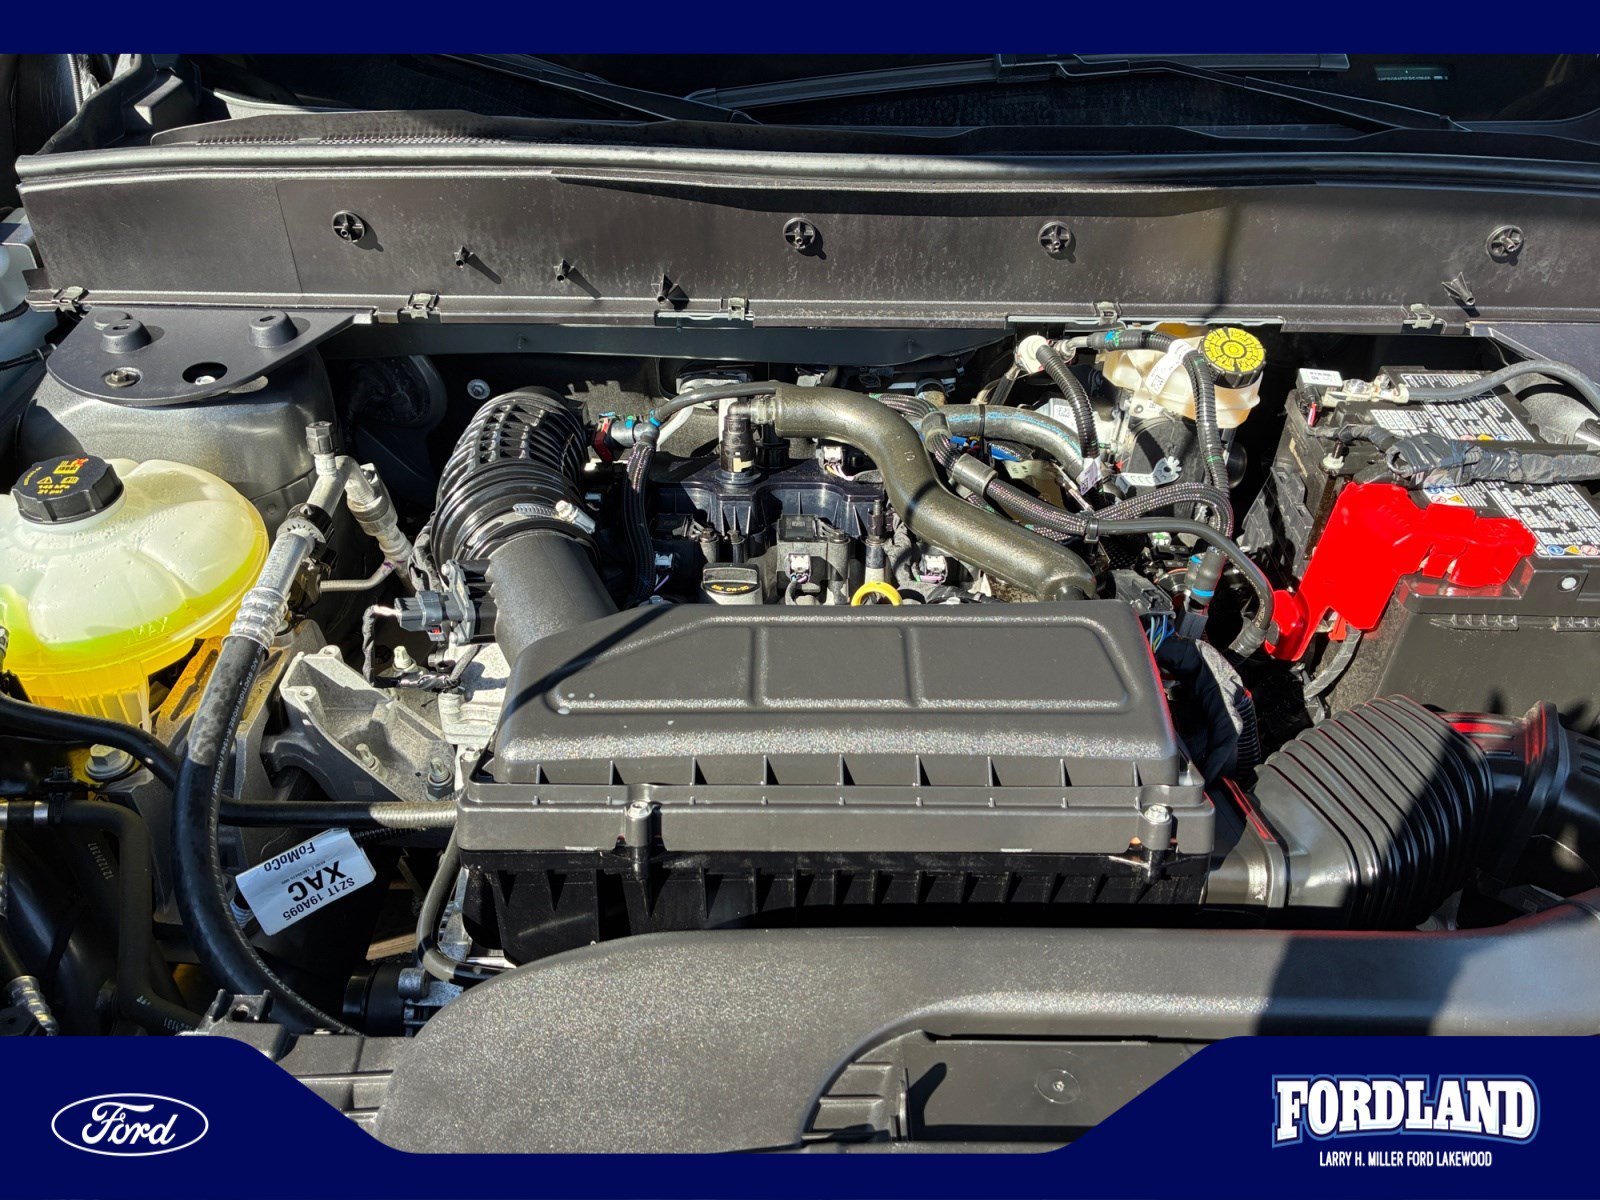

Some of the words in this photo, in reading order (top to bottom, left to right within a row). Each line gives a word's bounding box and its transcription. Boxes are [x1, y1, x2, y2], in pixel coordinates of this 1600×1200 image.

[237, 671, 253, 705] SUCTION
[228, 705, 240, 728] HOSE
[263, 841, 316, 872] FoMoCo
[287, 860, 347, 902] XAC
[327, 877, 355, 897] SZ1T
[282, 893, 324, 921] 19A095
[256, 959, 292, 995] GALAXY
